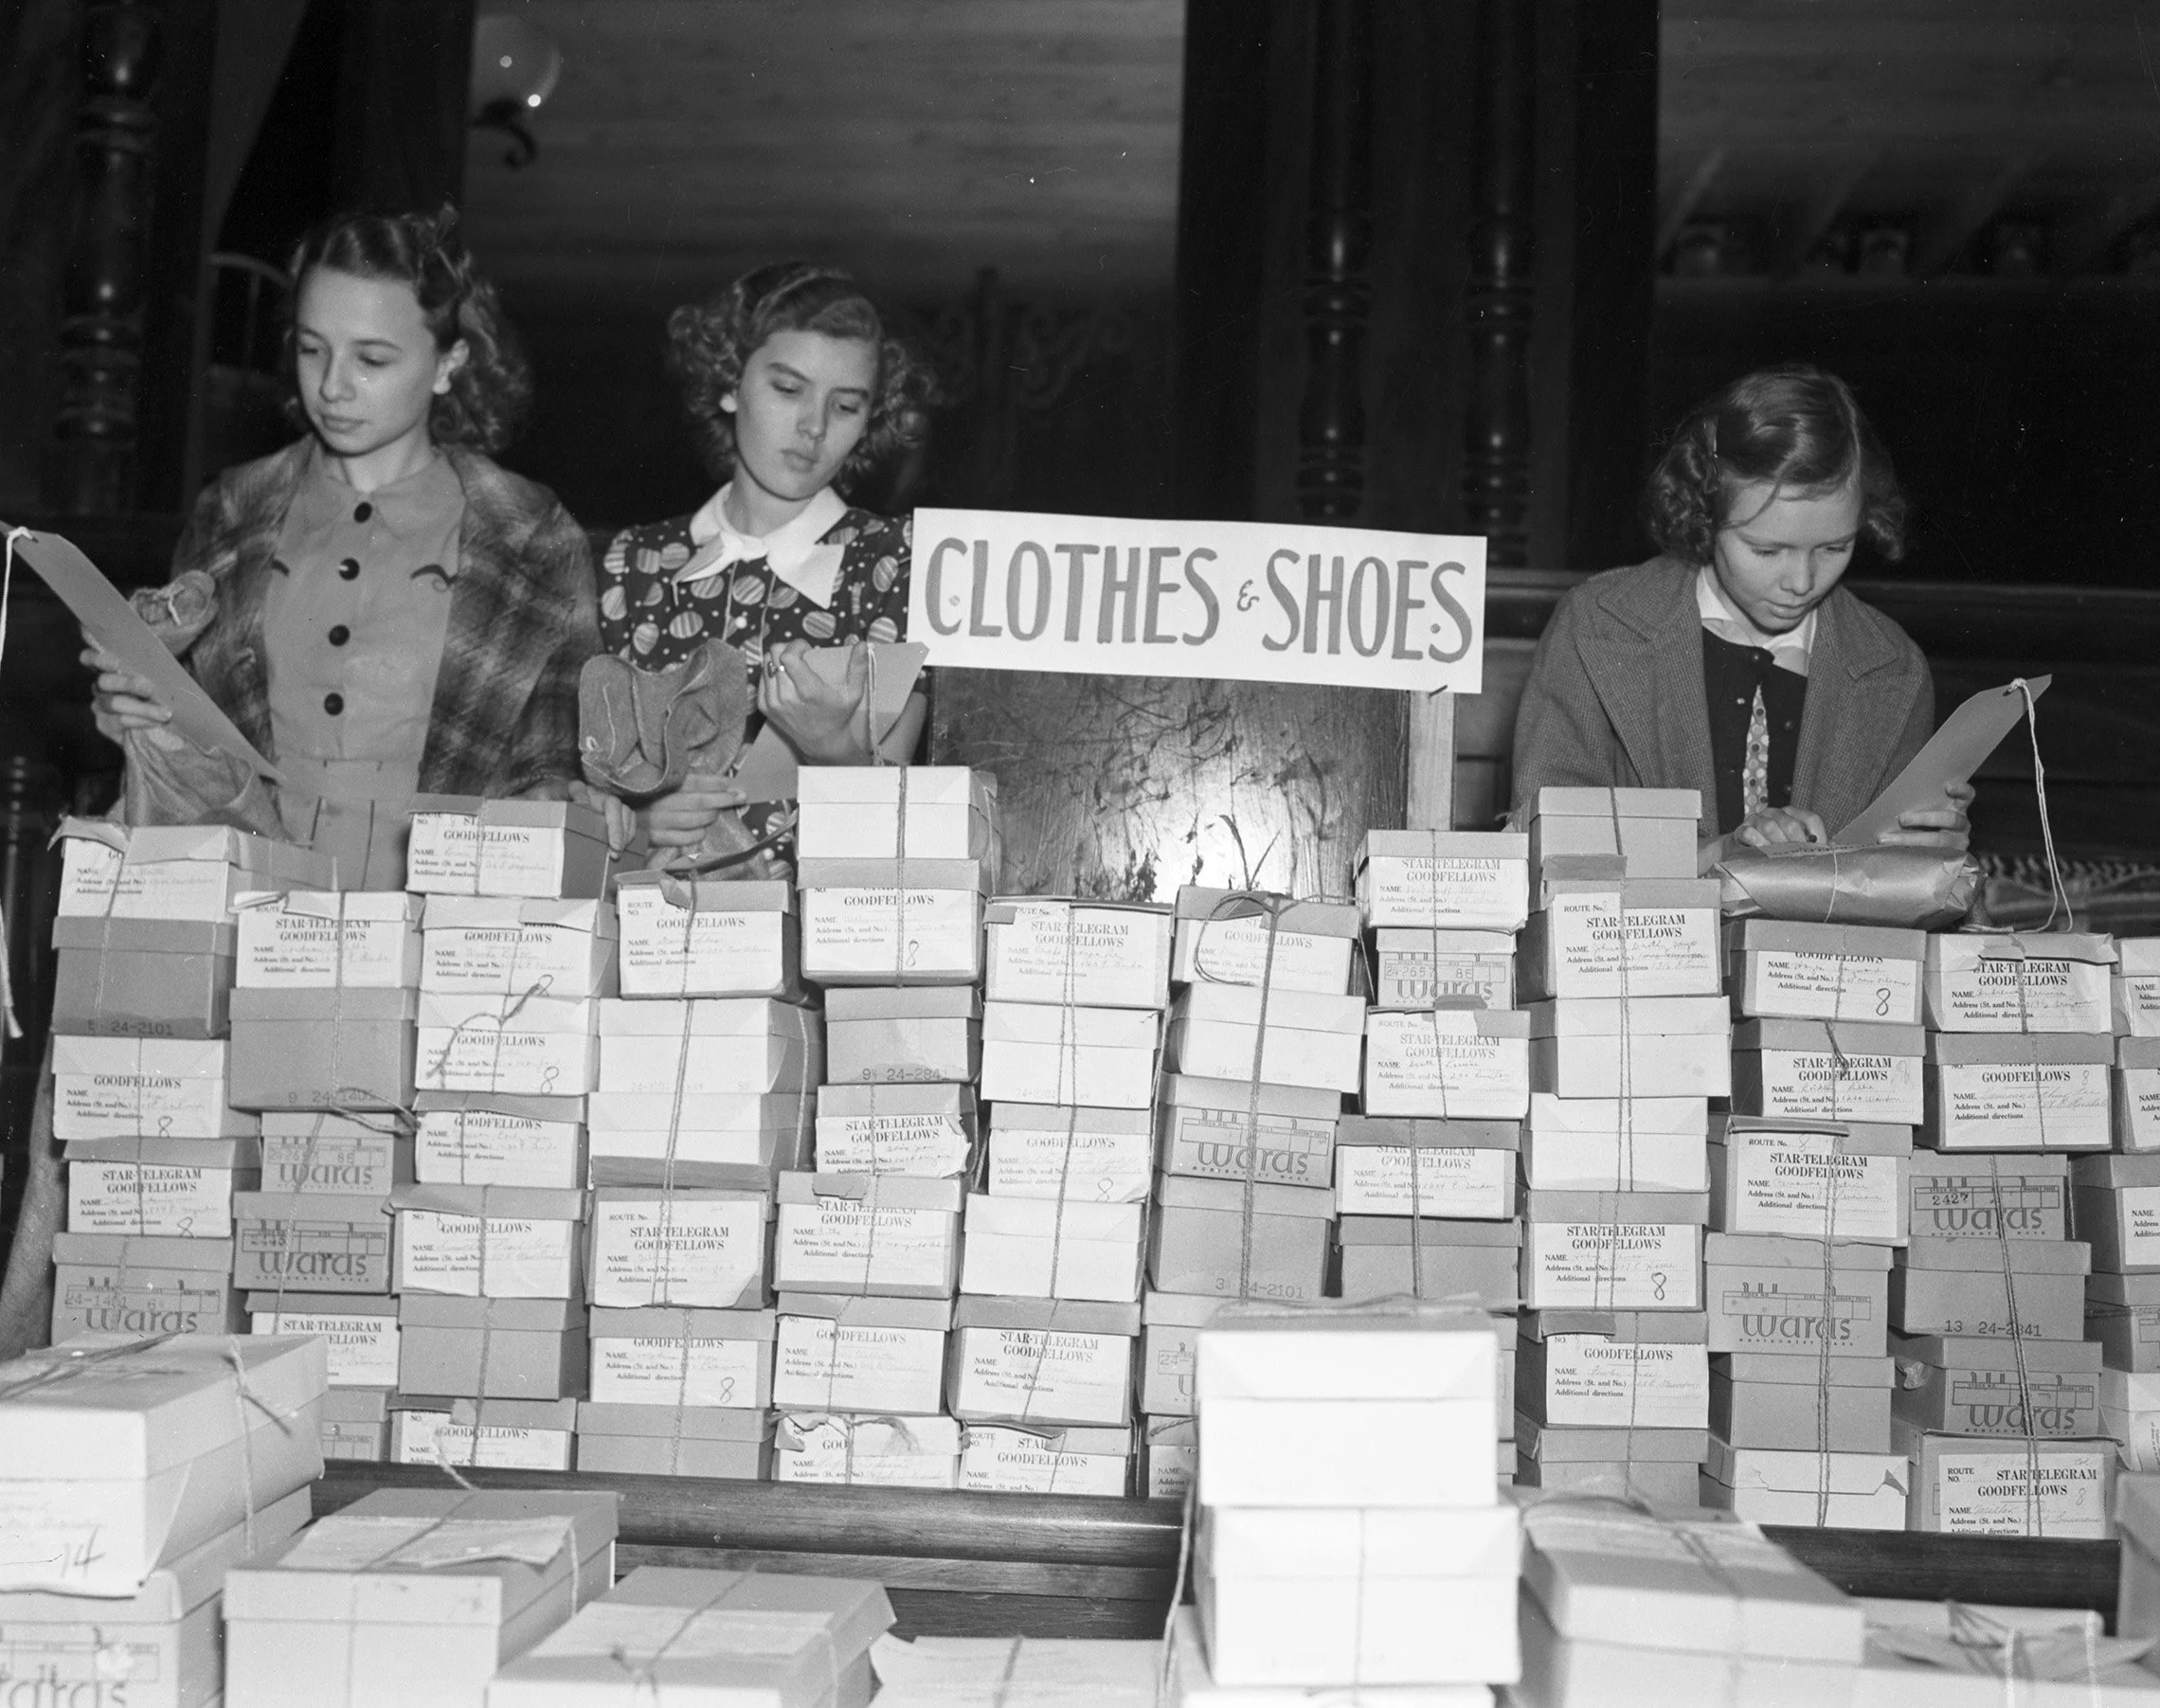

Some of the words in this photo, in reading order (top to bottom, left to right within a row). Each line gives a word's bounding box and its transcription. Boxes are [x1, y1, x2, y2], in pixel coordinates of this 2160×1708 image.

[925, 536, 1220, 646] CLOTHES
[1236, 579, 1260, 612] &
[1262, 548, 1474, 664] SHOES
[1402, 859, 1501, 870] STARTELEGRAM
[276, 919, 371, 929] STAR-TELERAM
[1225, 930, 1312, 947] GOODFLLOWS
[906, 940, 919, 966] 8
[1973, 962, 2070, 973] TAR-TLEGRAM
[1876, 988, 1891, 1016] 8
[1793, 1057, 1892, 1069] STAR-TEEGRAM
[540, 1067, 558, 1094] 8
[888, 1068, 944, 1081] 24-284
[1982, 1071, 2071, 1082] GOODFELLOWS
[94, 1076, 182, 1088] GOODFELLOWS
[158, 1116, 172, 1138] 8
[846, 1116, 943, 1131] STAR-TELEGRAM
[1098, 1178, 1113, 1201] 8
[1747, 1190, 1773, 1198] Address
[1775, 1191, 1786, 1199] (St.
[178, 1217, 193, 1237] 8
[1567, 1226, 1665, 1237] STARTELEGRAM
[634, 1240, 725, 1250] GOODFELLOWS
[1240, 1281, 1305, 1299] 4-2101
[1652, 1273, 1666, 1300] 8
[1945, 1321, 1962, 1332] 13
[720, 1377, 734, 1402] 8
[1585, 1379, 1595, 1388] (St.
[1612, 1379, 1626, 1388] No.)
[1997, 1470, 2097, 1480] STARTELEGRAM
